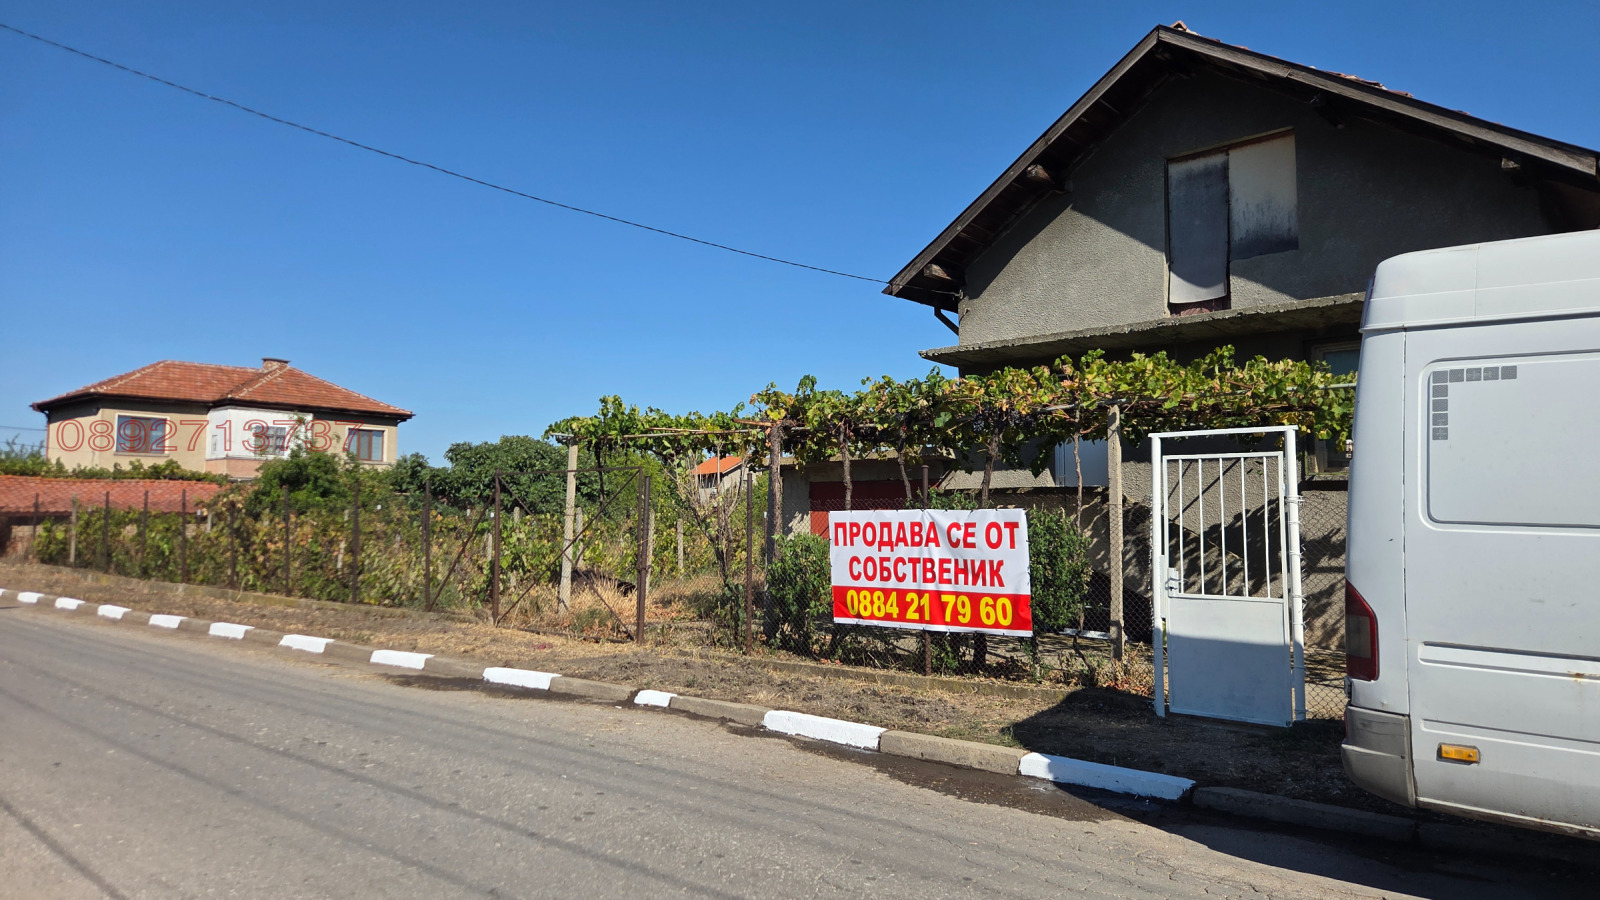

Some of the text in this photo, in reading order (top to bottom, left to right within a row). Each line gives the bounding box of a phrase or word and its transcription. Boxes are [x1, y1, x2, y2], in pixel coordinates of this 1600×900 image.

[834, 521, 1020, 552] ПРОДАВА СЕ ОТ
[848, 555, 1005, 588] СОБСТВЕНИК
[846, 589, 1013, 626] 0884 21 79 60
